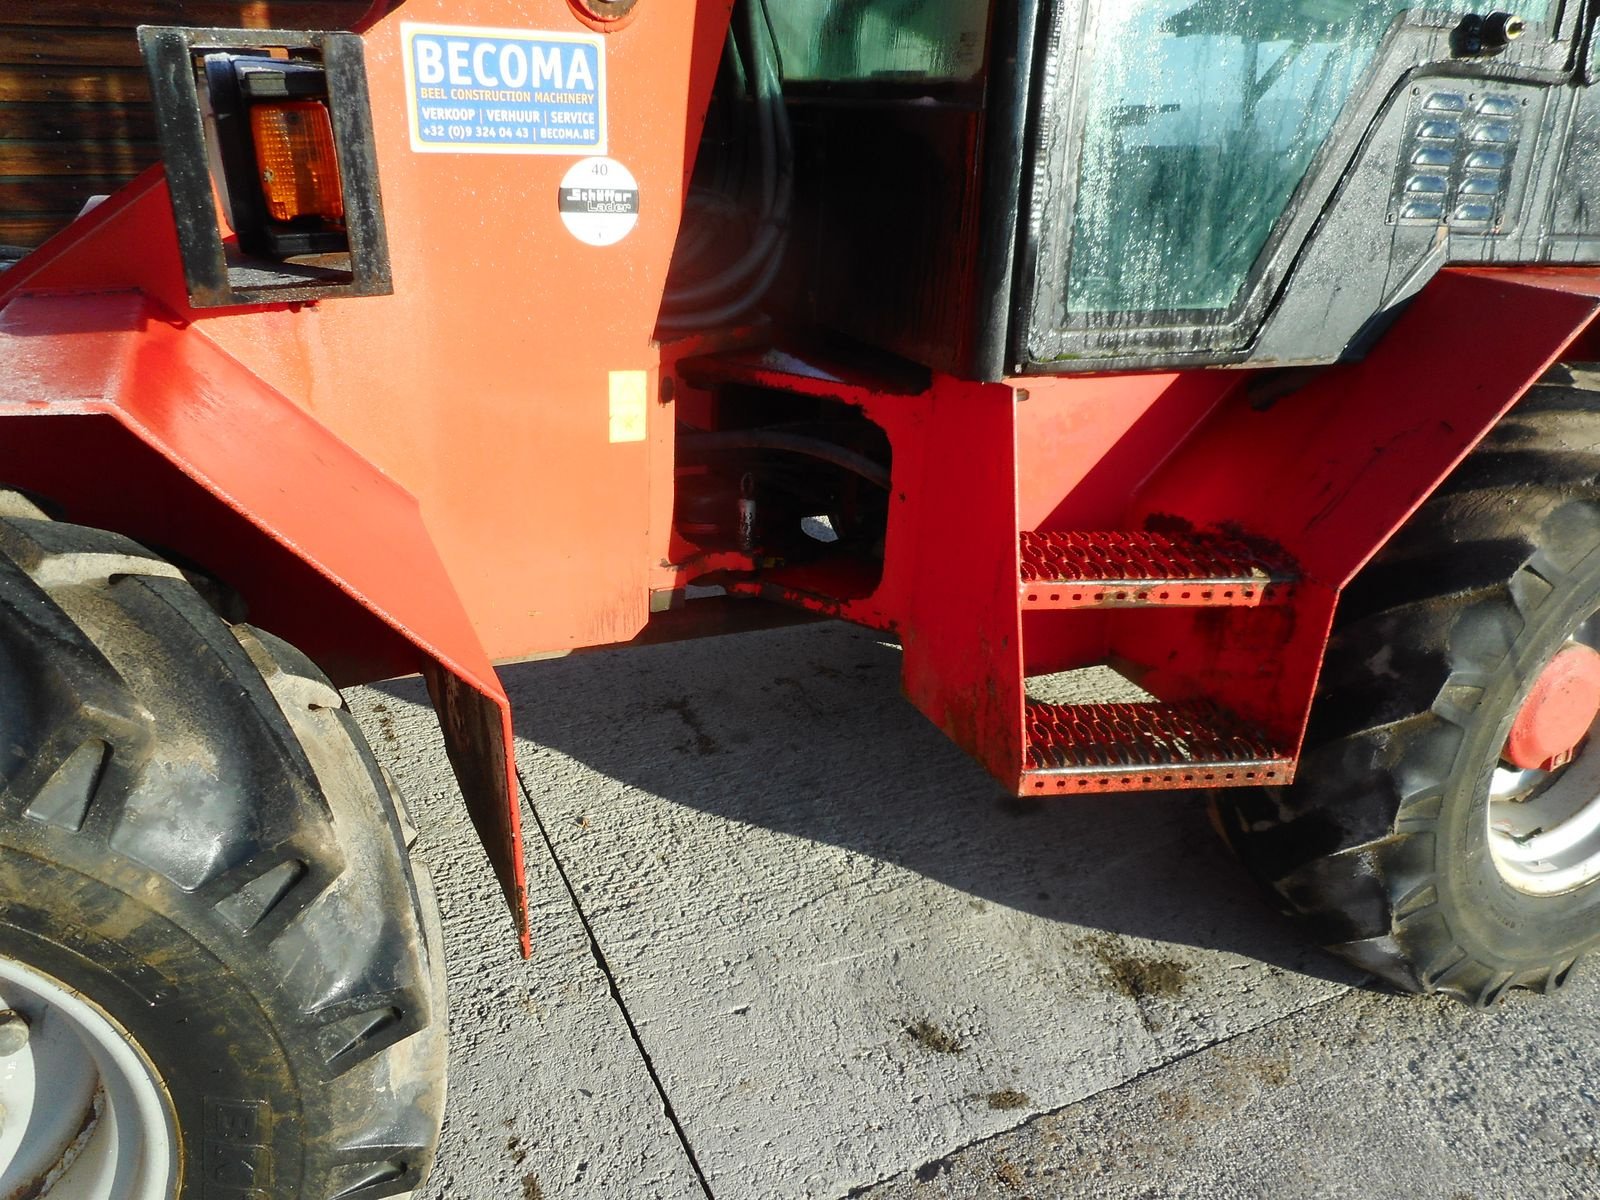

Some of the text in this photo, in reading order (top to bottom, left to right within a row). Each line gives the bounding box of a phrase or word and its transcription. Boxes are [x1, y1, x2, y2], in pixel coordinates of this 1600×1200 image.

[416, 39, 594, 90] BECOMA
[420, 87, 594, 105] BEEL CONSTRUCTION MACHINERY
[422, 107, 595, 125] VERKOOP VERHUUR SERVICE
[423, 125, 595, 140] +32 (0)9 324 04 43 BECOMA.BE
[591, 163, 608, 176] 40
